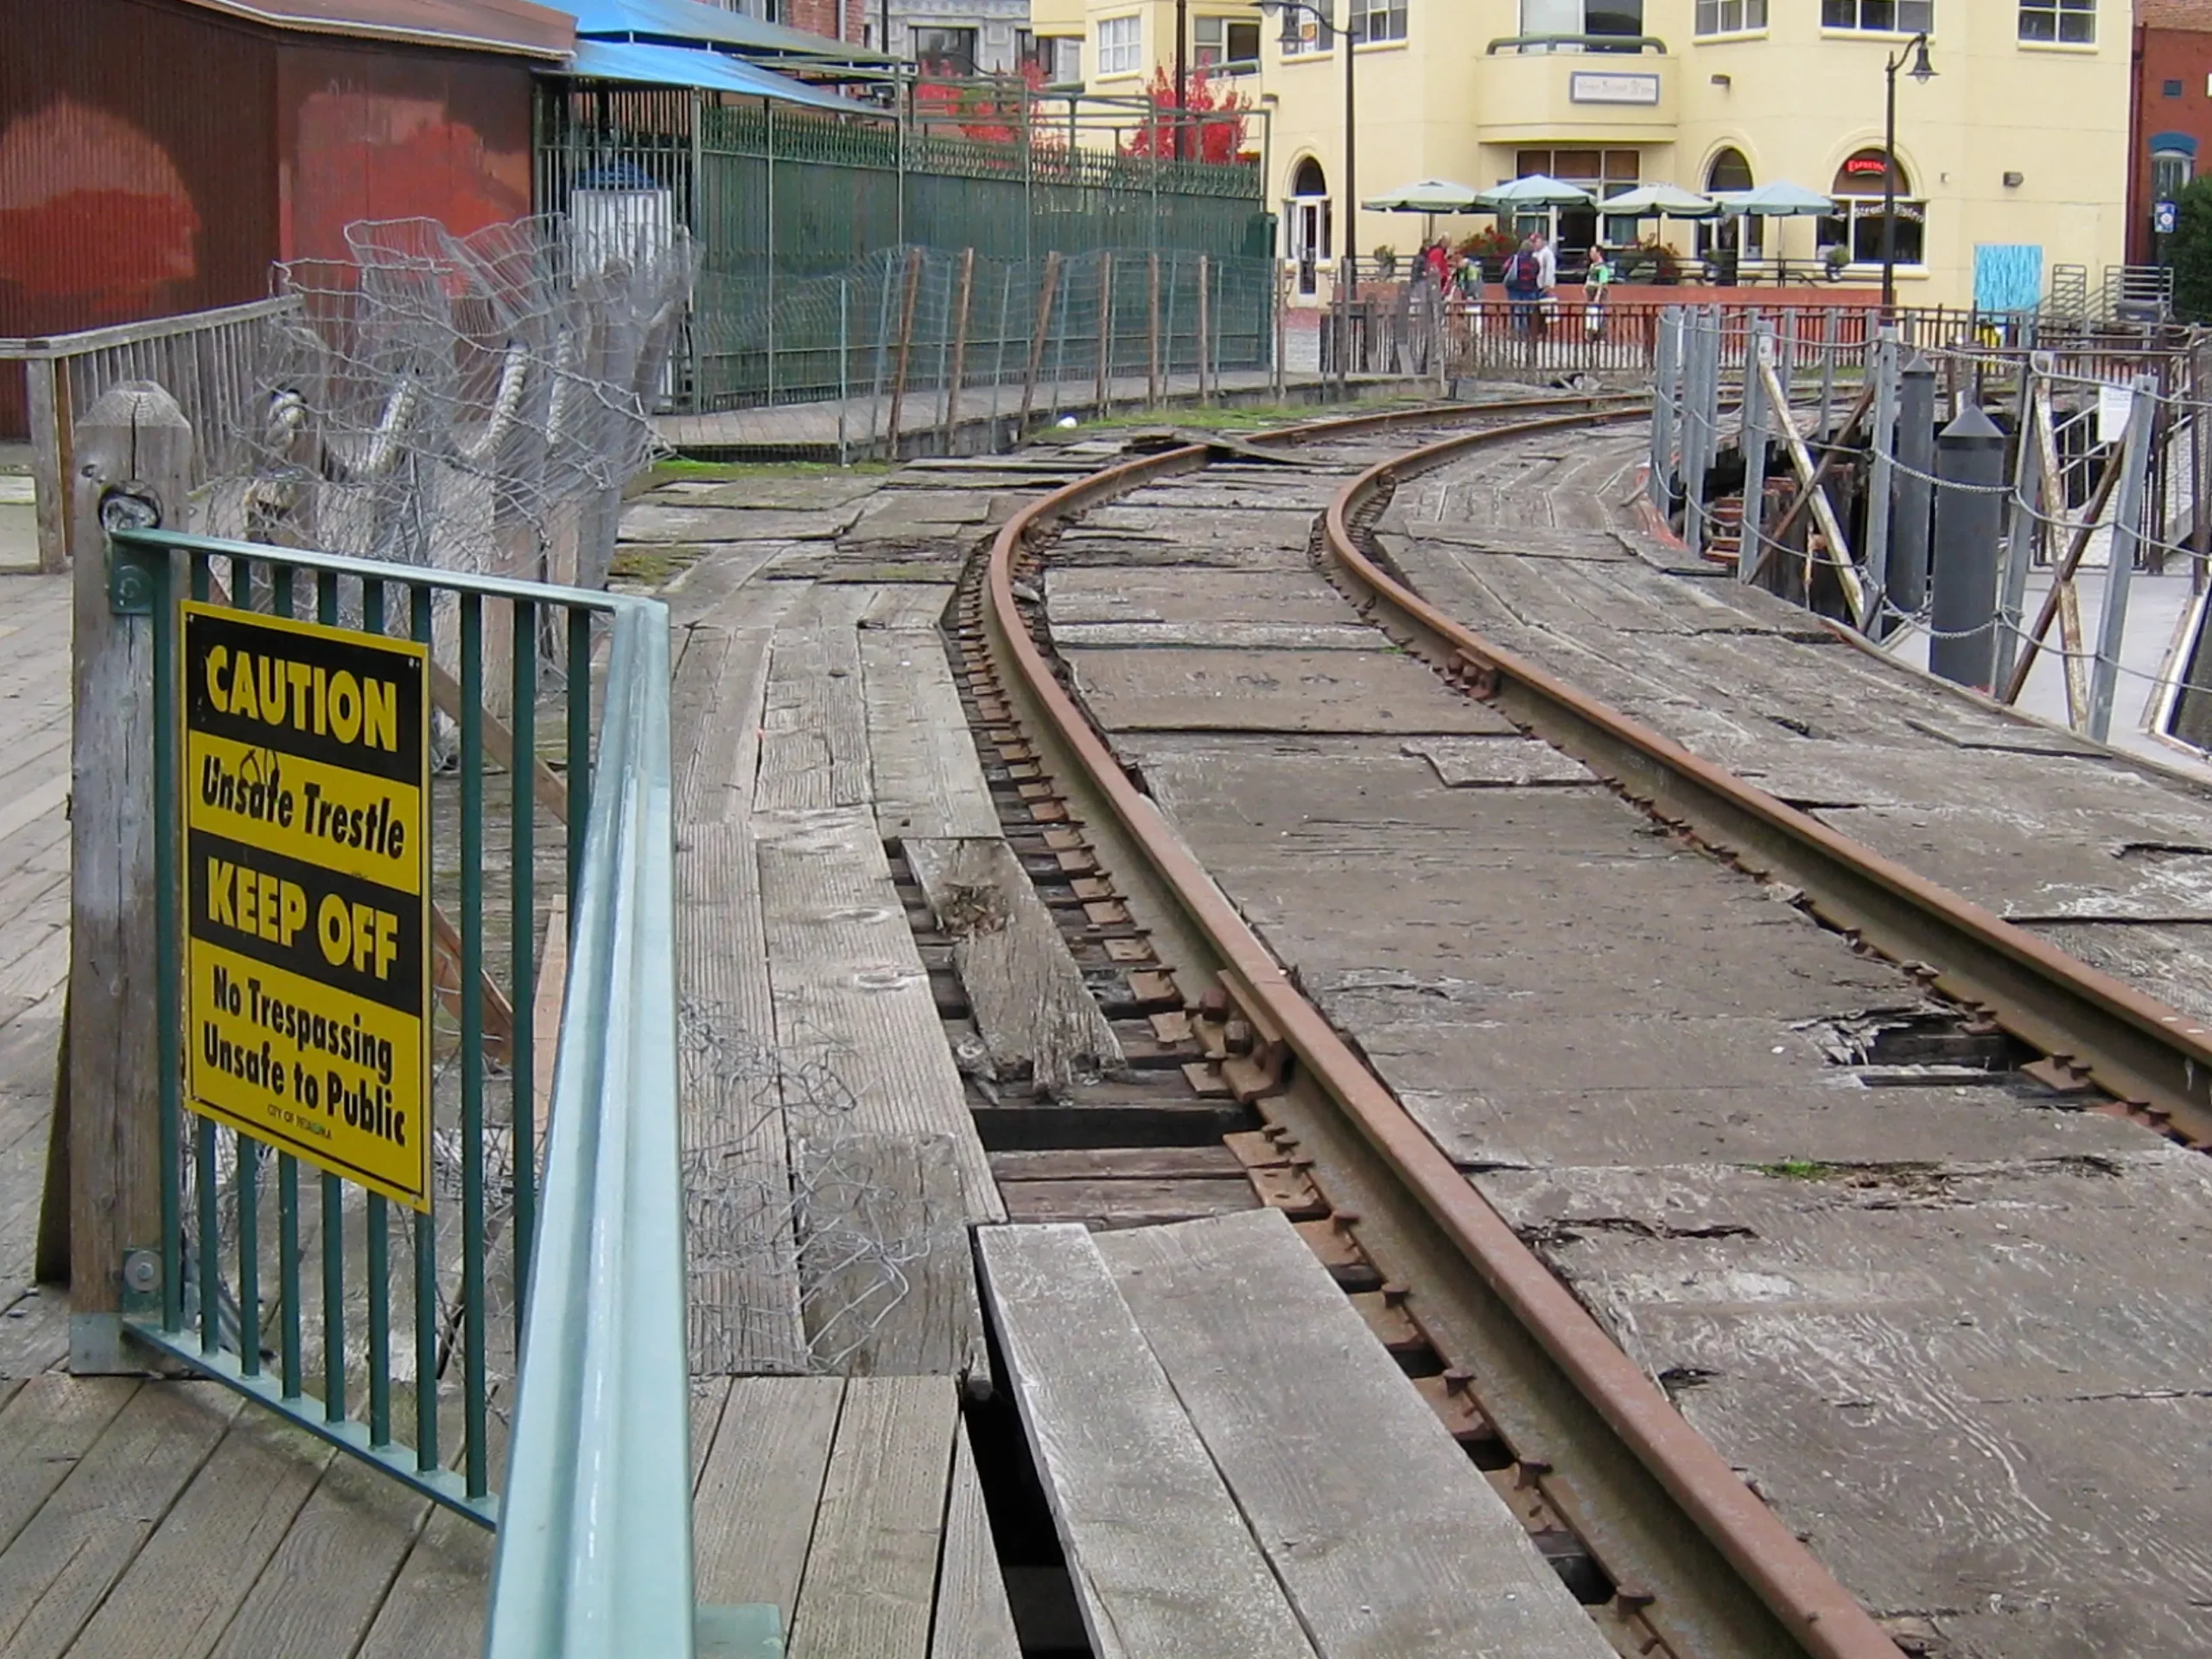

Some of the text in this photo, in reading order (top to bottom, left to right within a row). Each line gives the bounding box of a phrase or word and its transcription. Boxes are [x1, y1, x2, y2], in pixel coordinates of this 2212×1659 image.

[205, 644, 397, 753] CAUTION
[201, 753, 404, 860] Unsafe Trestle
[207, 855, 398, 981] KEEP OFF
[203, 1020, 407, 1147] Unsafe to Public
[213, 963, 393, 1086] No Trespassing
